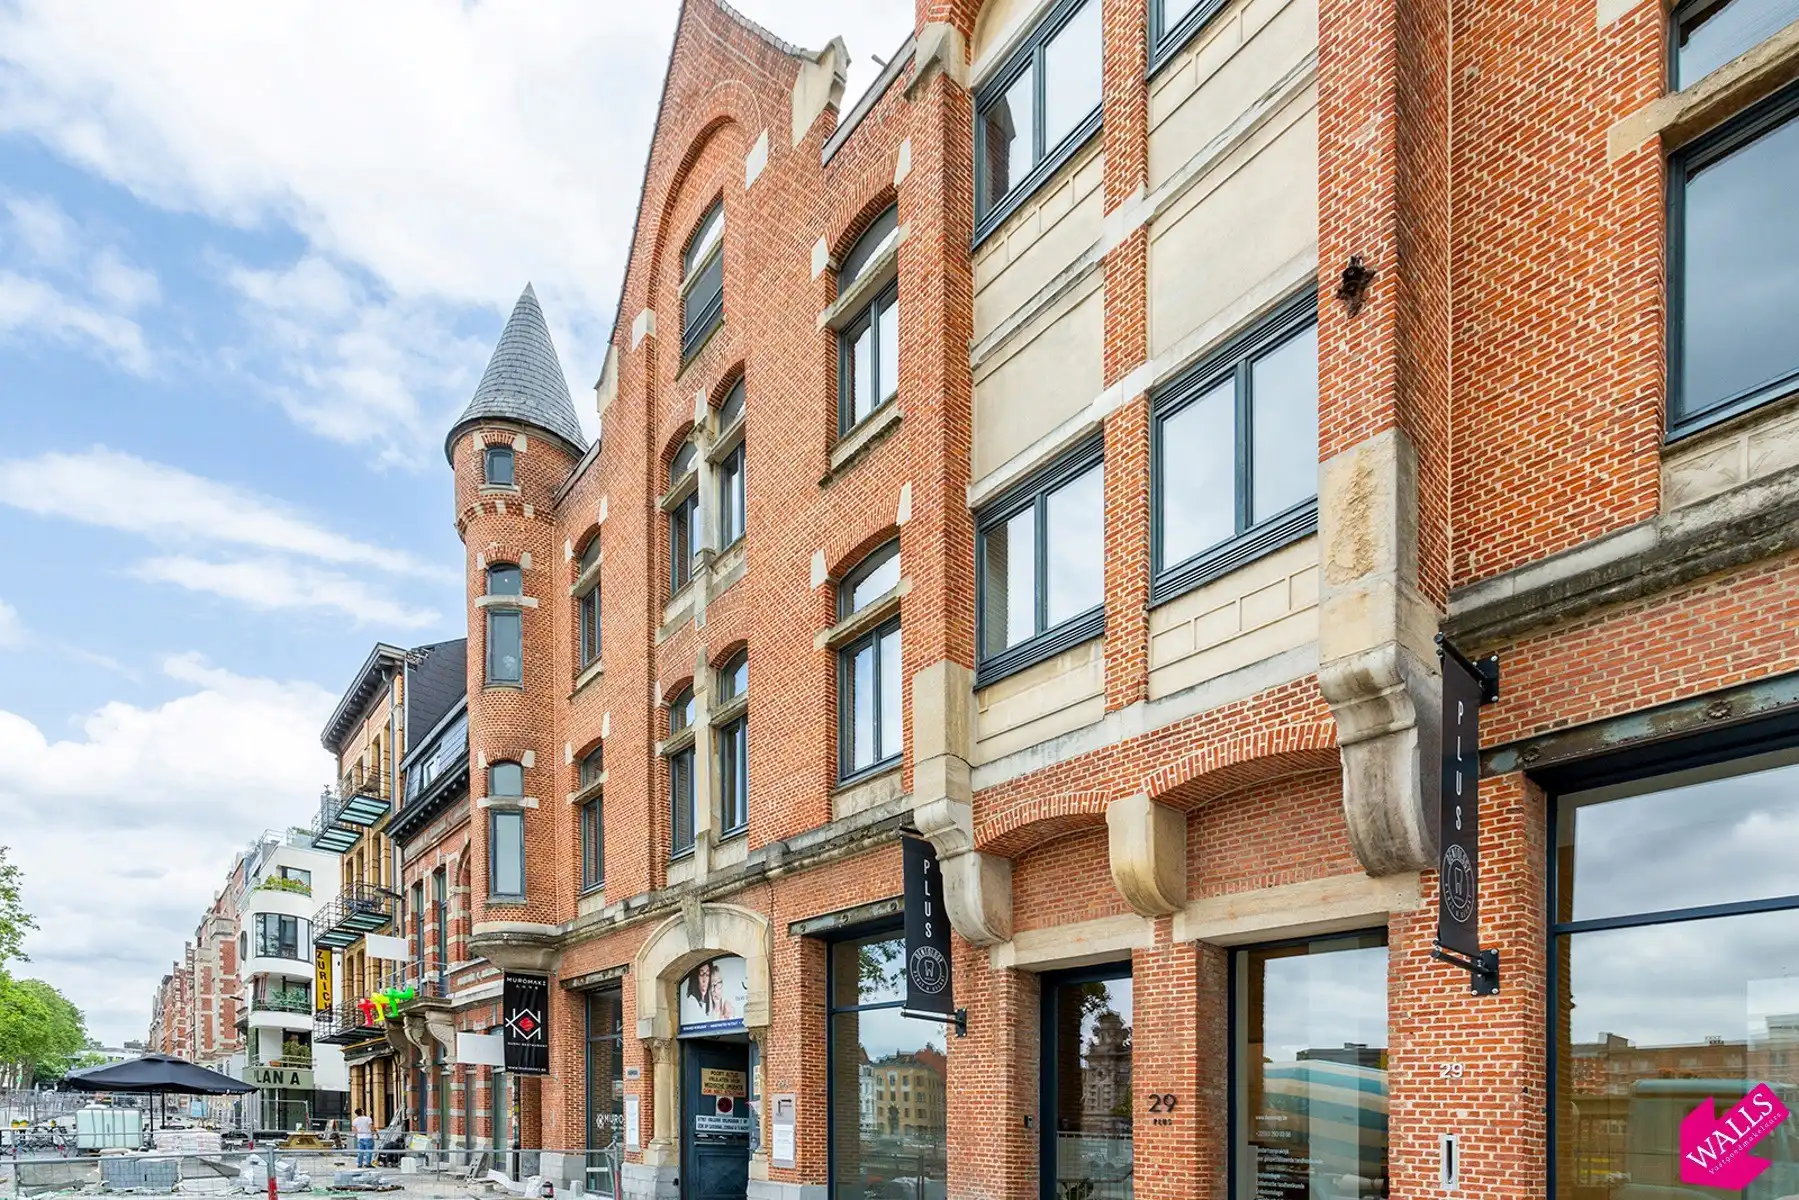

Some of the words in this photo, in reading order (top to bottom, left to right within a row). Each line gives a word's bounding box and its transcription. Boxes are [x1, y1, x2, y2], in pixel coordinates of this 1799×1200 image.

[1456, 701, 1464, 831] PLUS
[923, 859, 932, 938] PLUS
[317, 951, 332, 1010] ZURICH
[290, 1072, 300, 1086] A
[1440, 1063, 1463, 1078] 29
[1148, 1093, 1177, 1112] 29
